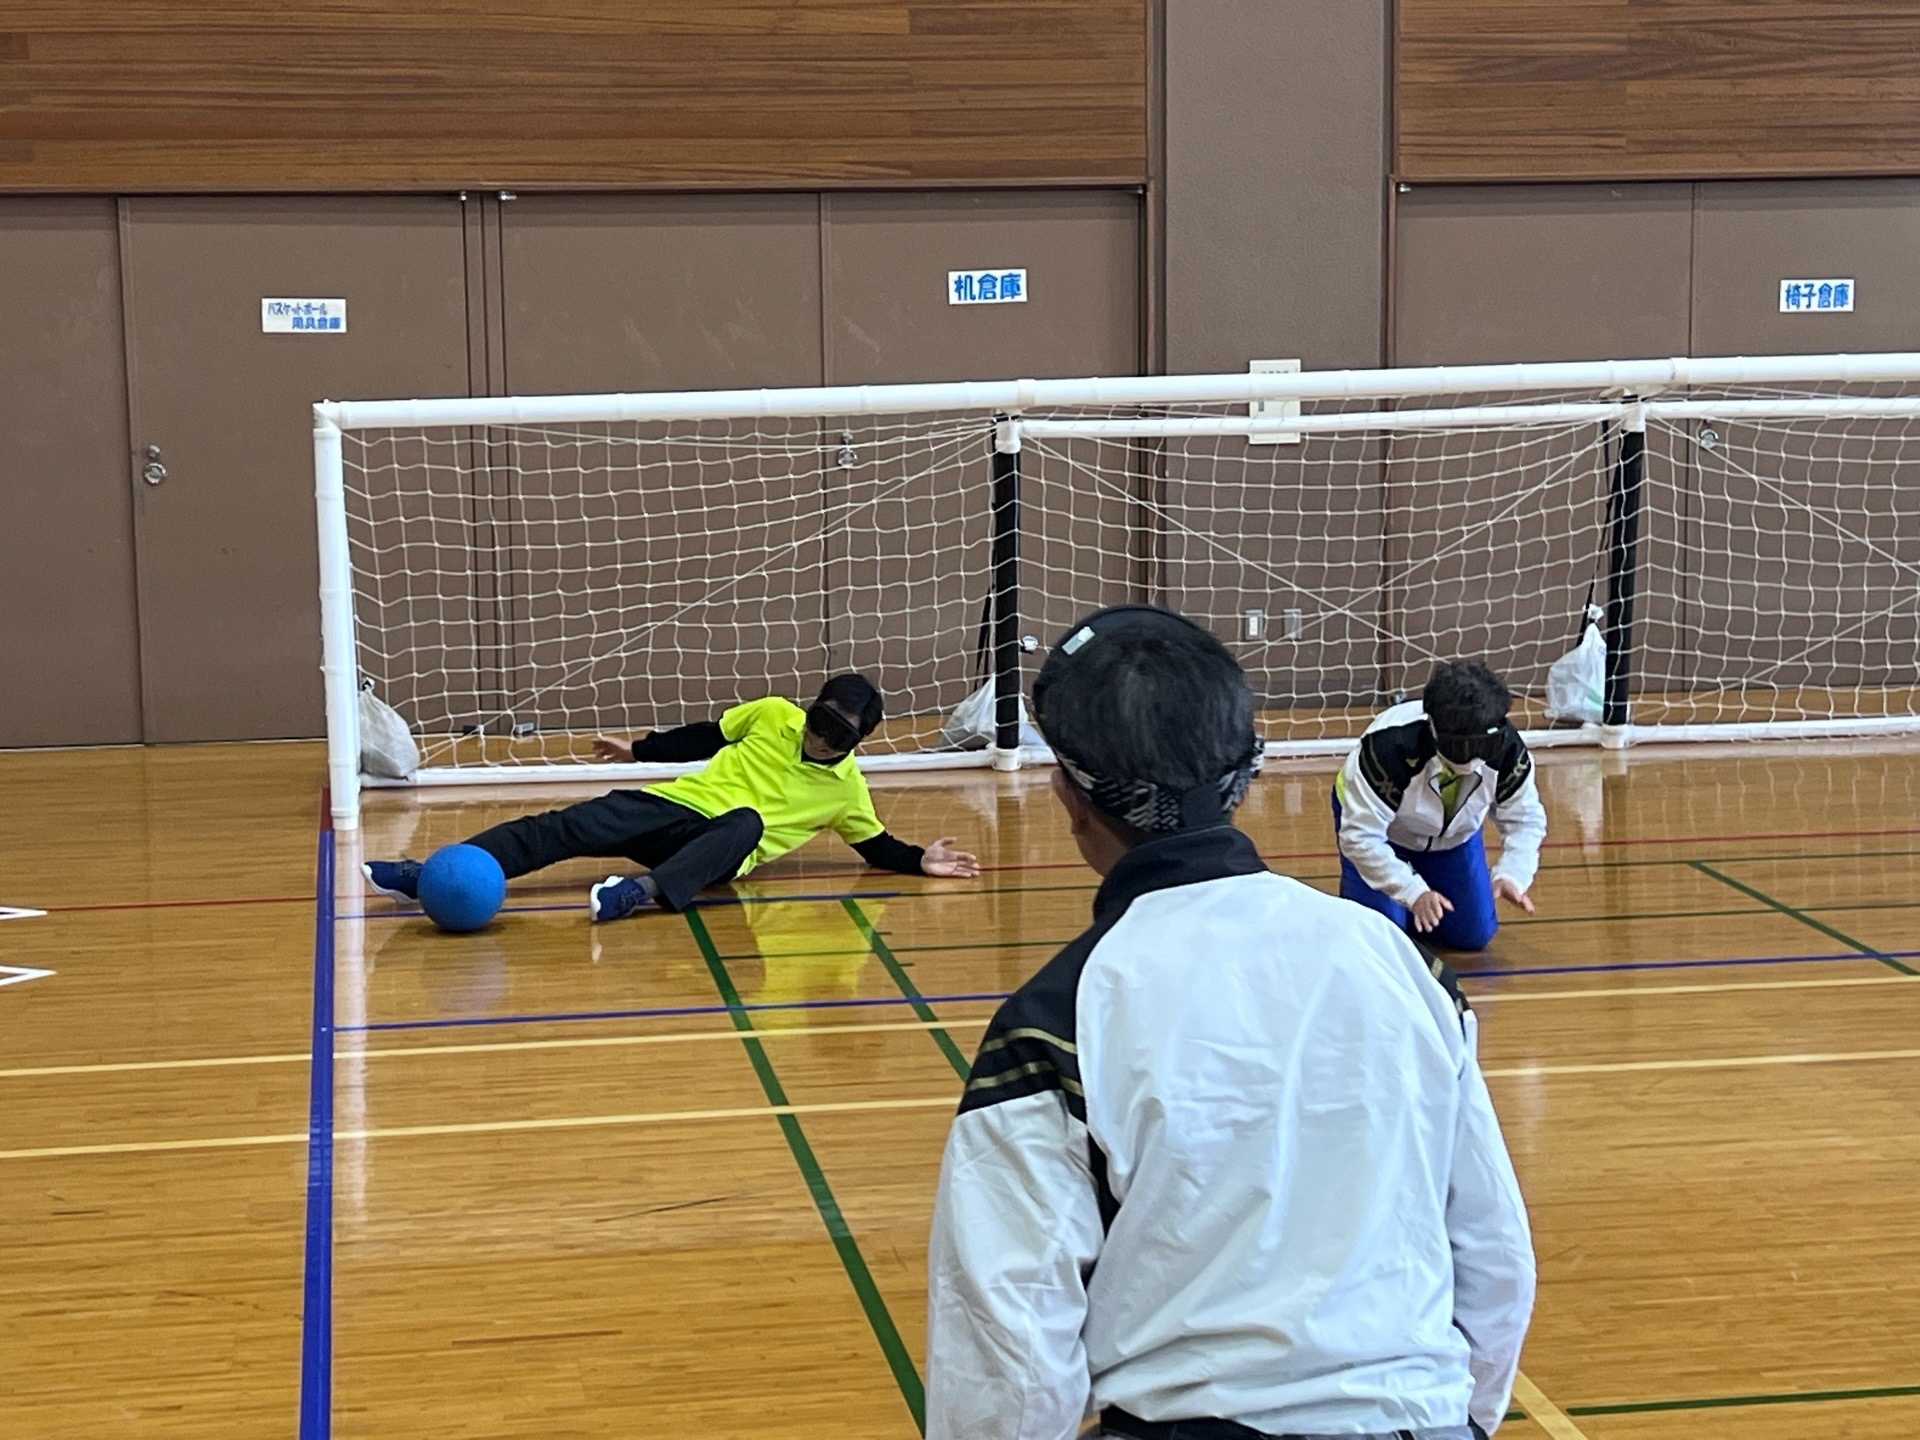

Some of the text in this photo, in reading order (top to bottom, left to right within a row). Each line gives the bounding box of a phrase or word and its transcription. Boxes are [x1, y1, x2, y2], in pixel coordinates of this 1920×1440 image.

[954, 272, 1022, 301] 机倉庫
[1785, 283, 1849, 310] 椅子倉庫
